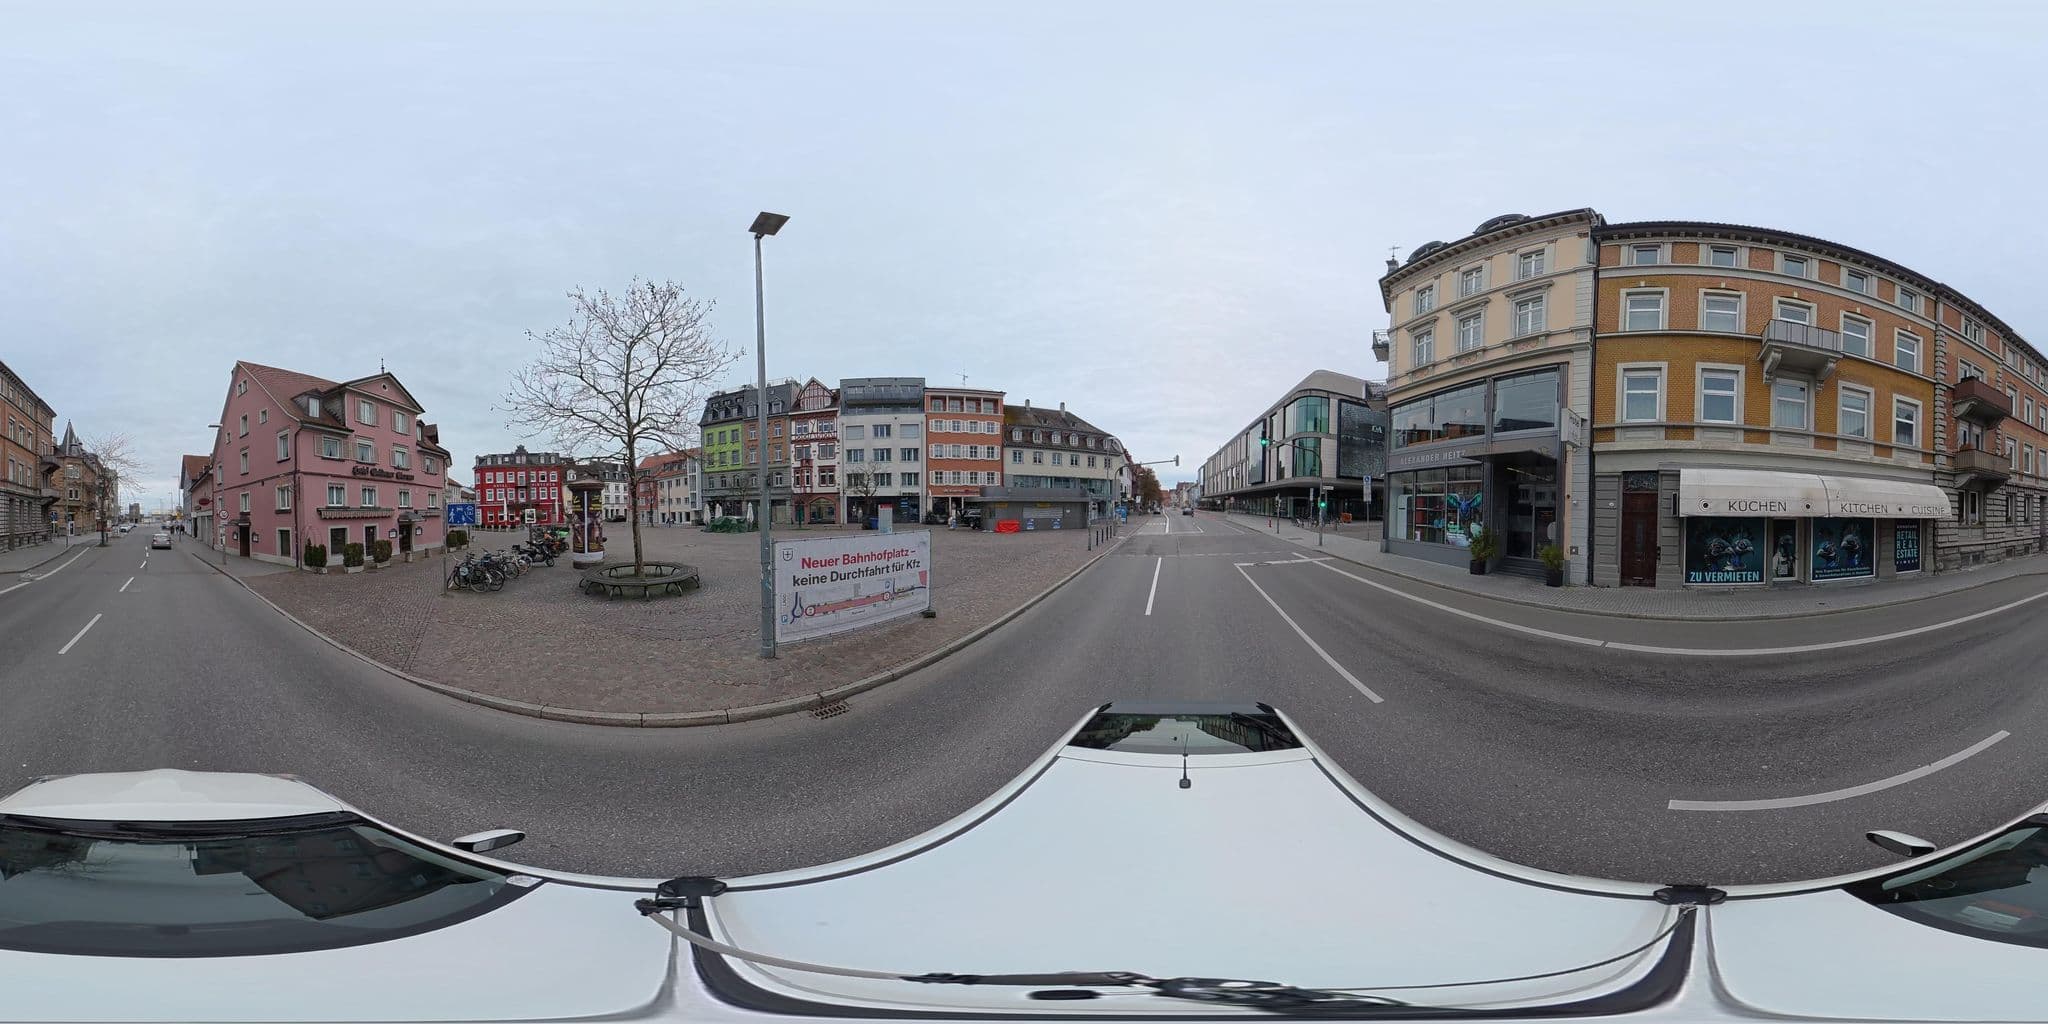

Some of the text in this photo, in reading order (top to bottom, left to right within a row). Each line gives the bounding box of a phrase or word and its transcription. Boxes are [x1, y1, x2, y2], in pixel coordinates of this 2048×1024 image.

[1400, 453, 1439, 465] ALEXANDER
[1728, 500, 1787, 512] KÜCHEN
[1841, 503, 1888, 514] KITCHEN
[1911, 505, 1945, 515] CUISINE
[1896, 531, 1918, 539] RETAIL
[1896, 540, 1918, 549] REAL
[801, 556, 840, 569] Neuer
[842, 548, 909, 566] Bahnhofplatz
[1896, 549, 1918, 558] ESTATE
[792, 559, 921, 587] keine Durchfahrt für Kfz
[1690, 570, 1760, 582] ZU VERMIETEN
